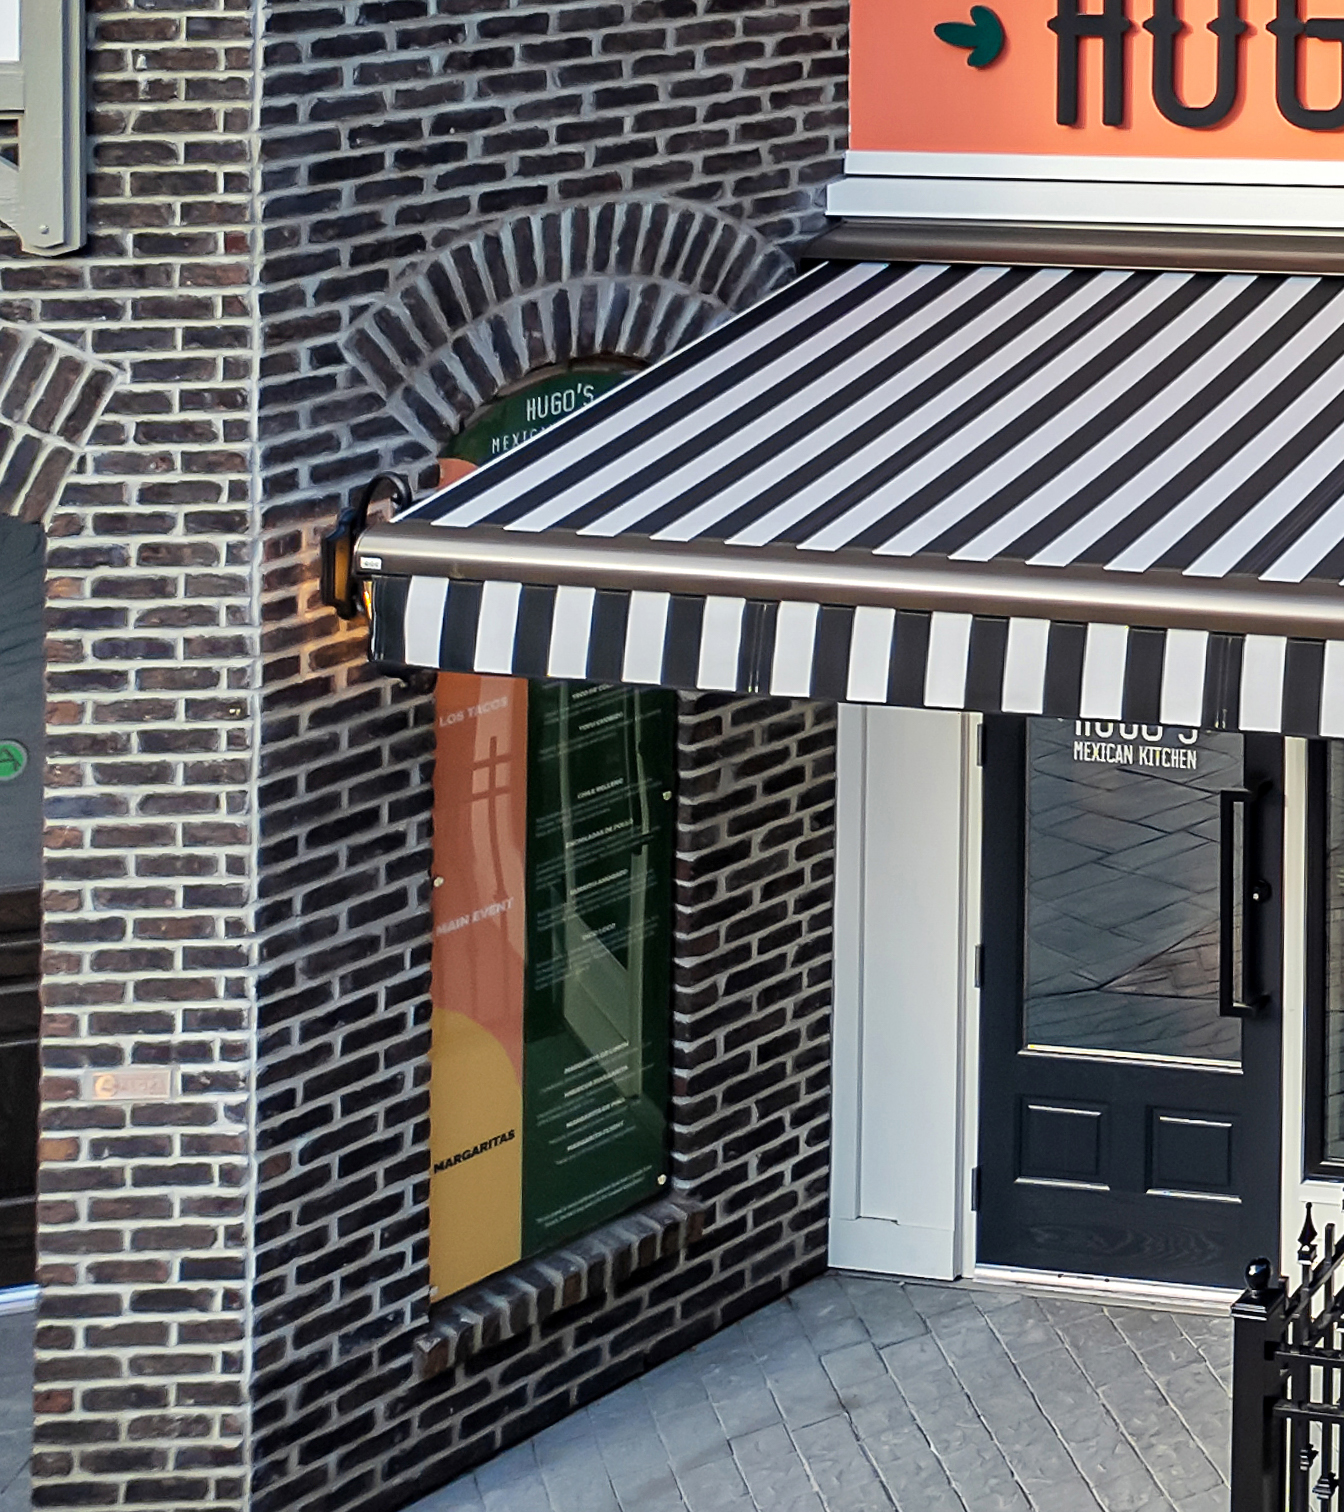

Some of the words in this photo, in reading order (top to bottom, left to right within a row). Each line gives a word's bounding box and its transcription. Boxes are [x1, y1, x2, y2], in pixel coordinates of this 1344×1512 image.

[526, 383, 594, 422] HUGO'S
[439, 711, 465, 727] LOS
[468, 696, 508, 718] TACOS
[1074, 741, 1133, 765] MEXICAN
[1139, 746, 1197, 769] KITCHEN
[436, 915, 471, 936] MAIN
[472, 897, 514, 920] EVENT
[433, 1129, 516, 1174] MARGARITAS
